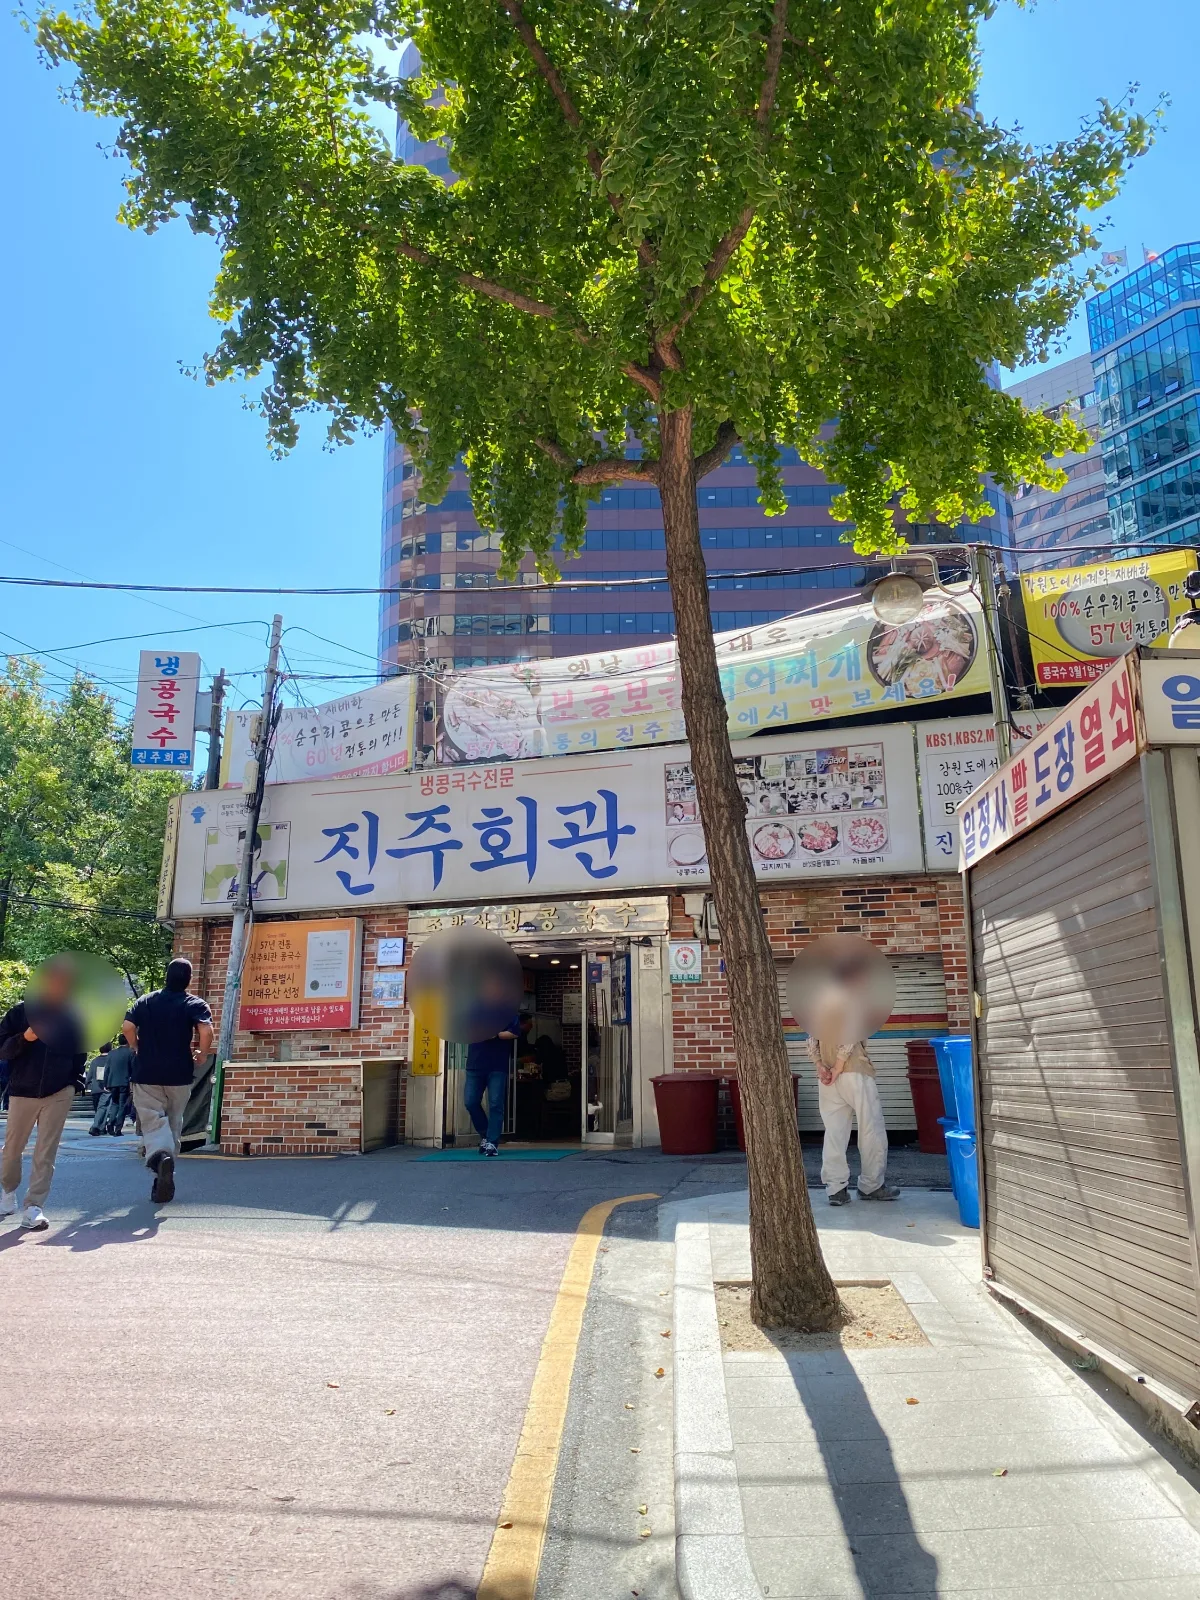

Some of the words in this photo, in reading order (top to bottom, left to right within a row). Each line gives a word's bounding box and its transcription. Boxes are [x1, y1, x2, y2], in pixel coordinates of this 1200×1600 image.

[1025, 573, 1082, 594] 강원도에서
[1087, 567, 1109, 586] 계약
[1115, 562, 1150, 581] 재배한
[1043, 664, 1067, 680] 콩국수
[147, 656, 180, 747] 냉콩국수
[810, 696, 832, 716] 맛
[851, 674, 956, 709] 보세요!
[137, 751, 188, 763] 진주회관
[382, 754, 404, 773] 합니다
[940, 758, 999, 777] 강원도에서
[420, 768, 514, 795] 냉콩국수전문
[964, 780, 1007, 860] 일정사
[1011, 759, 1028, 827] 빠른
[314, 789, 636, 895] 진주회관
[260, 941, 275, 950] 57년
[278, 939, 291, 950] 전통
[250, 952, 277, 964] 진주회관
[280, 951, 301, 961] 콩국수
[254, 973, 295, 986] 서울특별시
[248, 987, 281, 999] 미래유산
[283, 986, 299, 999] 선정
